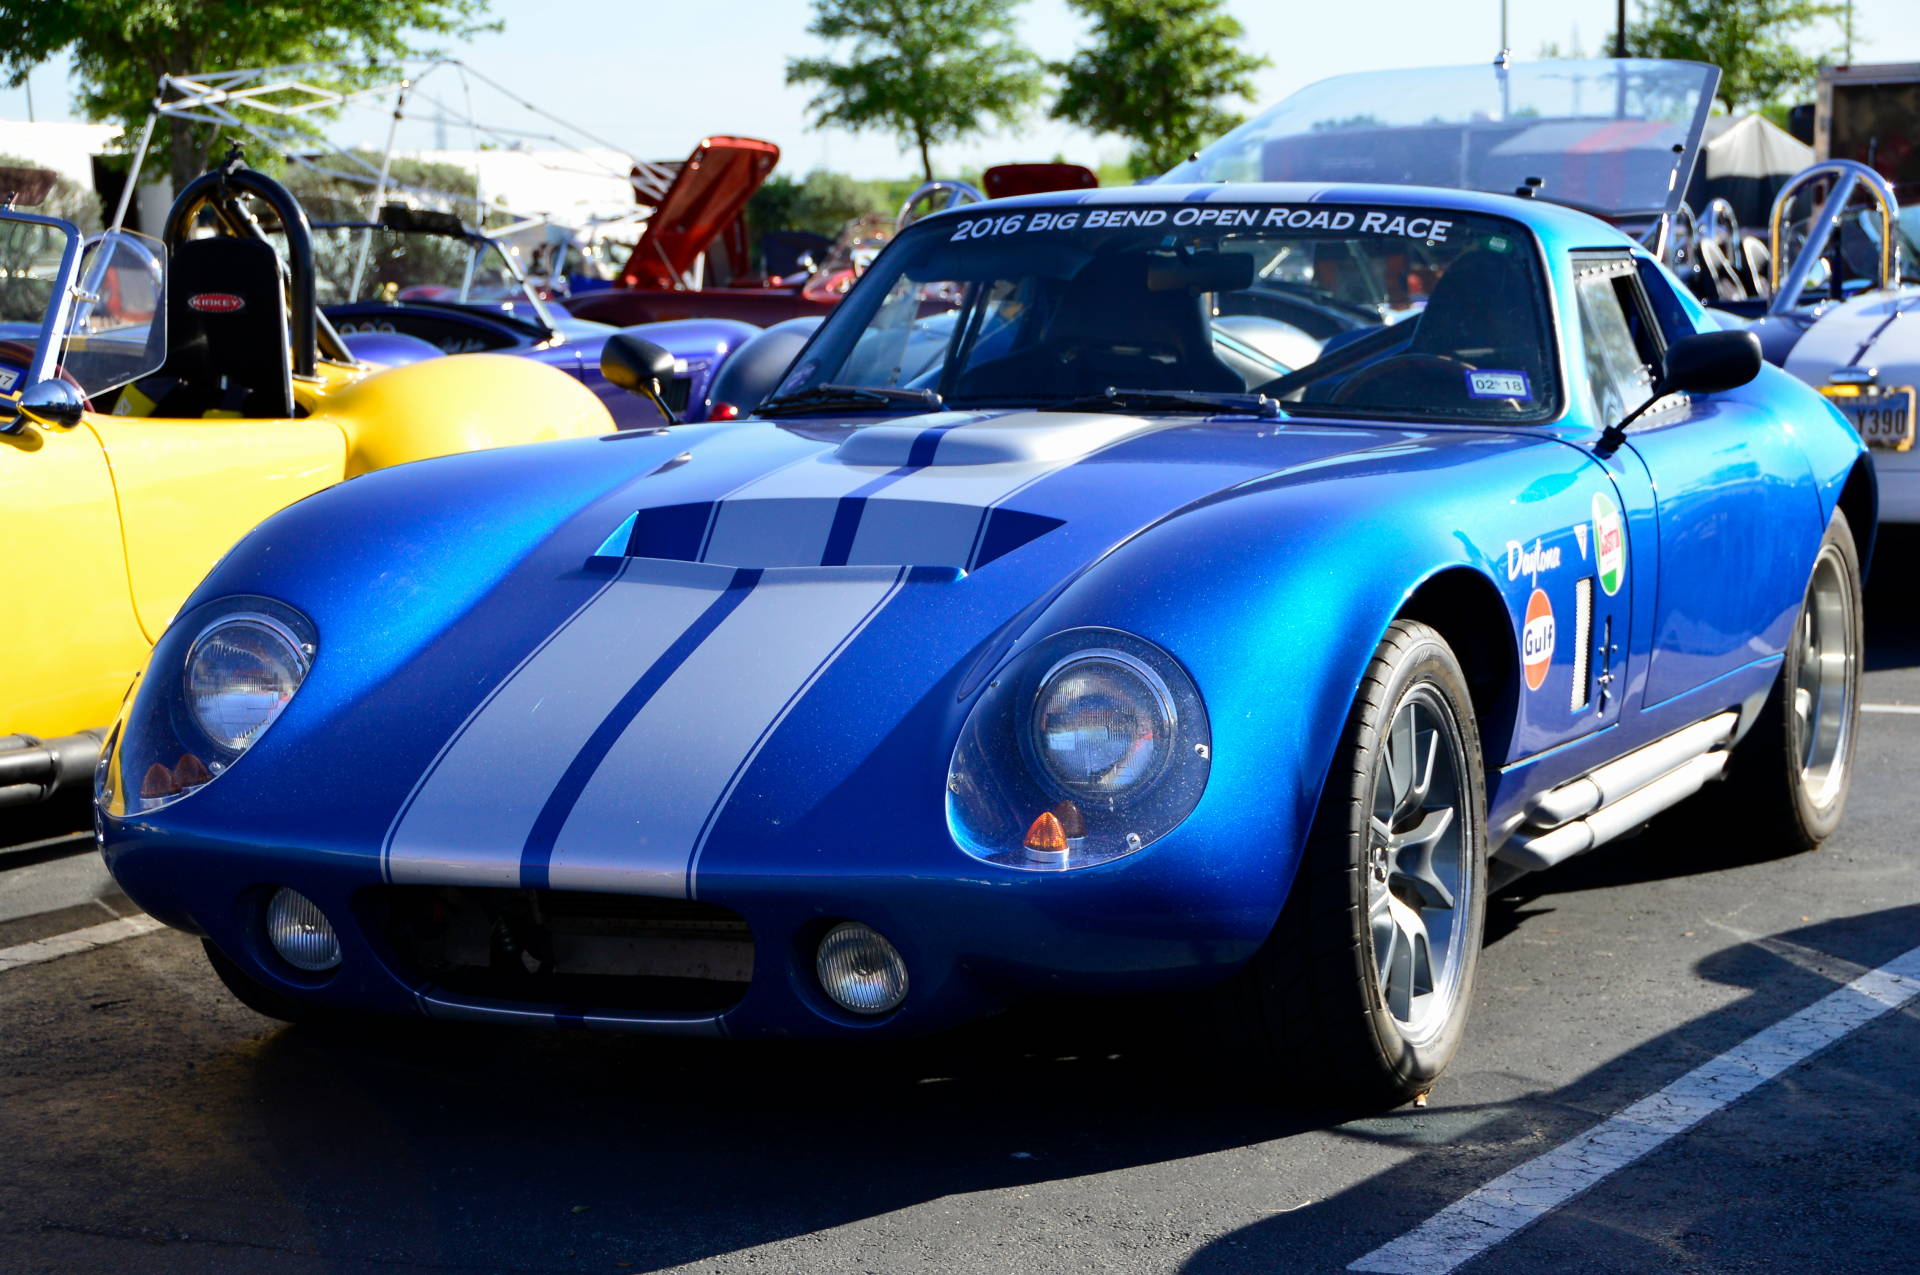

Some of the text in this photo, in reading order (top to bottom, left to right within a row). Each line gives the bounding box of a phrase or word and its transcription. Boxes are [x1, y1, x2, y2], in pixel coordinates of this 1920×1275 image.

[950, 208, 1453, 242] 2016 BIG BEND OPEN ROAD RACE
[1475, 379, 1522, 391] 02 18
[1506, 538, 1561, 588] Daytona
[1525, 623, 1552, 657] Gulf
